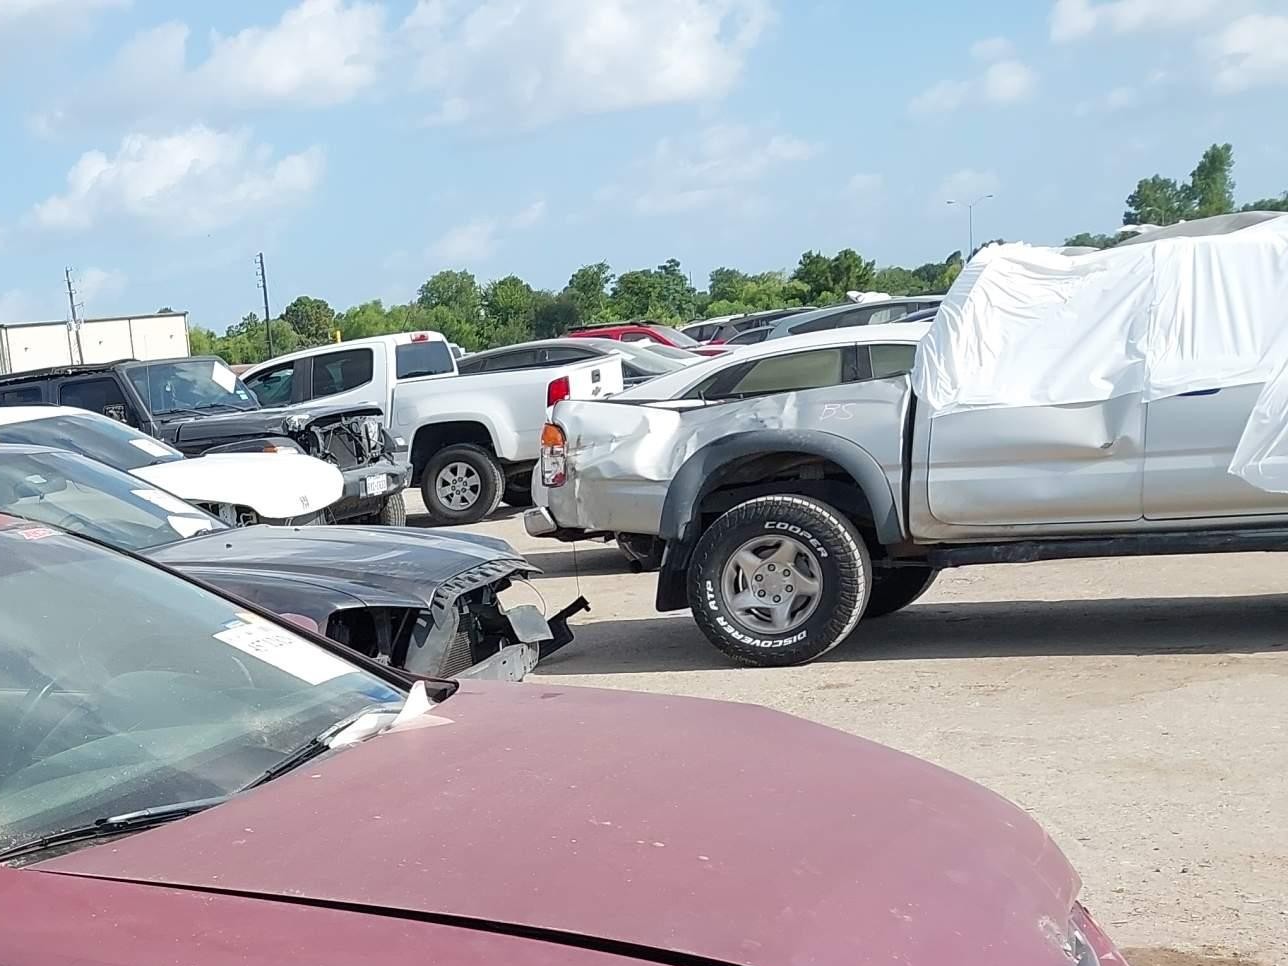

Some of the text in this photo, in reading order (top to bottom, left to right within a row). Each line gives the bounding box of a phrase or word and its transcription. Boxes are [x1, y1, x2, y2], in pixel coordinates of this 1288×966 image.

[764, 521, 828, 557] COOPER
[706, 580, 807, 648] DISCOVERER ATP
